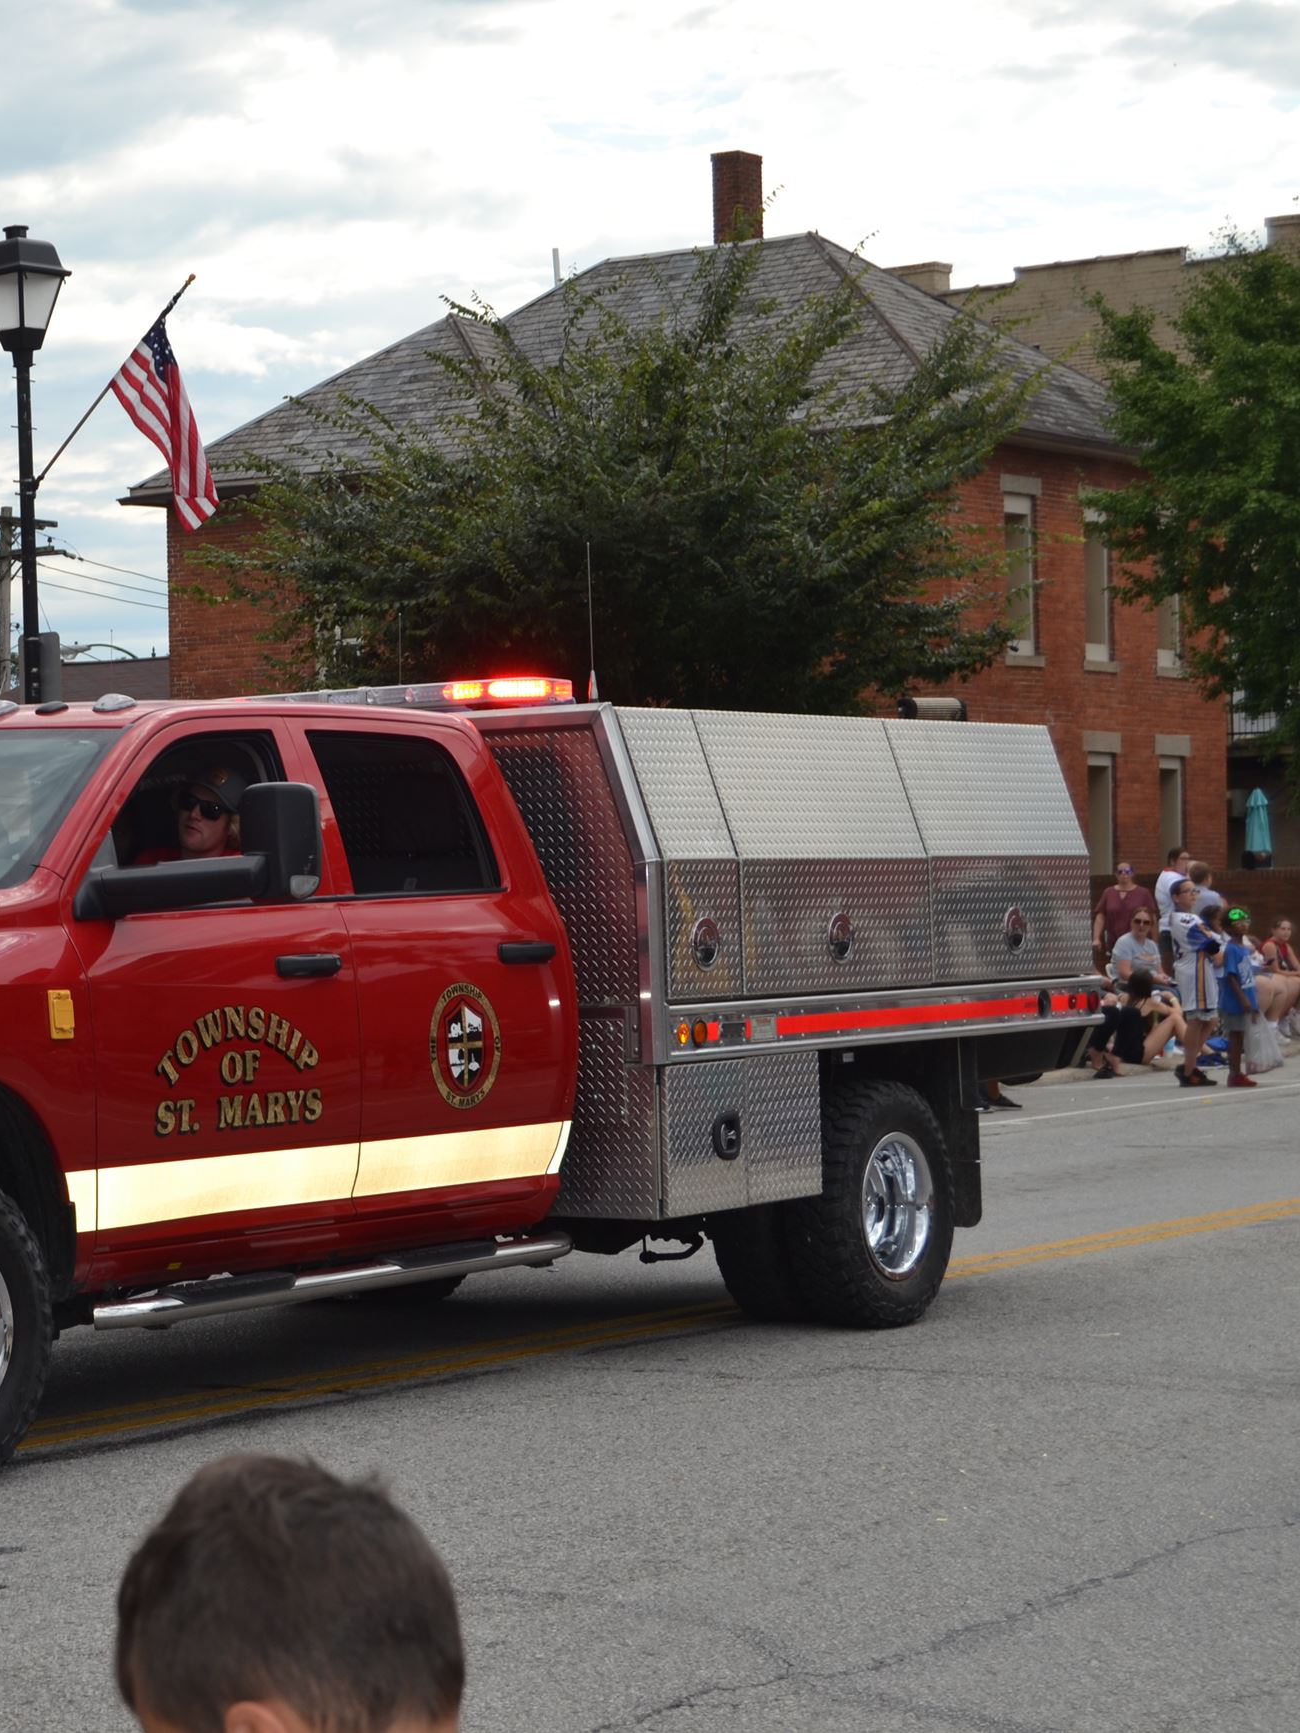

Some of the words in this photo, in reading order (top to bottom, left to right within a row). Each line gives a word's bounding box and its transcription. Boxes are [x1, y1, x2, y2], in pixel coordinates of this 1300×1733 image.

[442, 983, 483, 1002] TOWNSHIP
[155, 1005, 320, 1086] TOWNSHIP
[220, 1050, 261, 1085] OF
[156, 1099, 200, 1136] ST.
[217, 1088, 324, 1129] MARYS
[458, 1089, 486, 1108] MARYS
